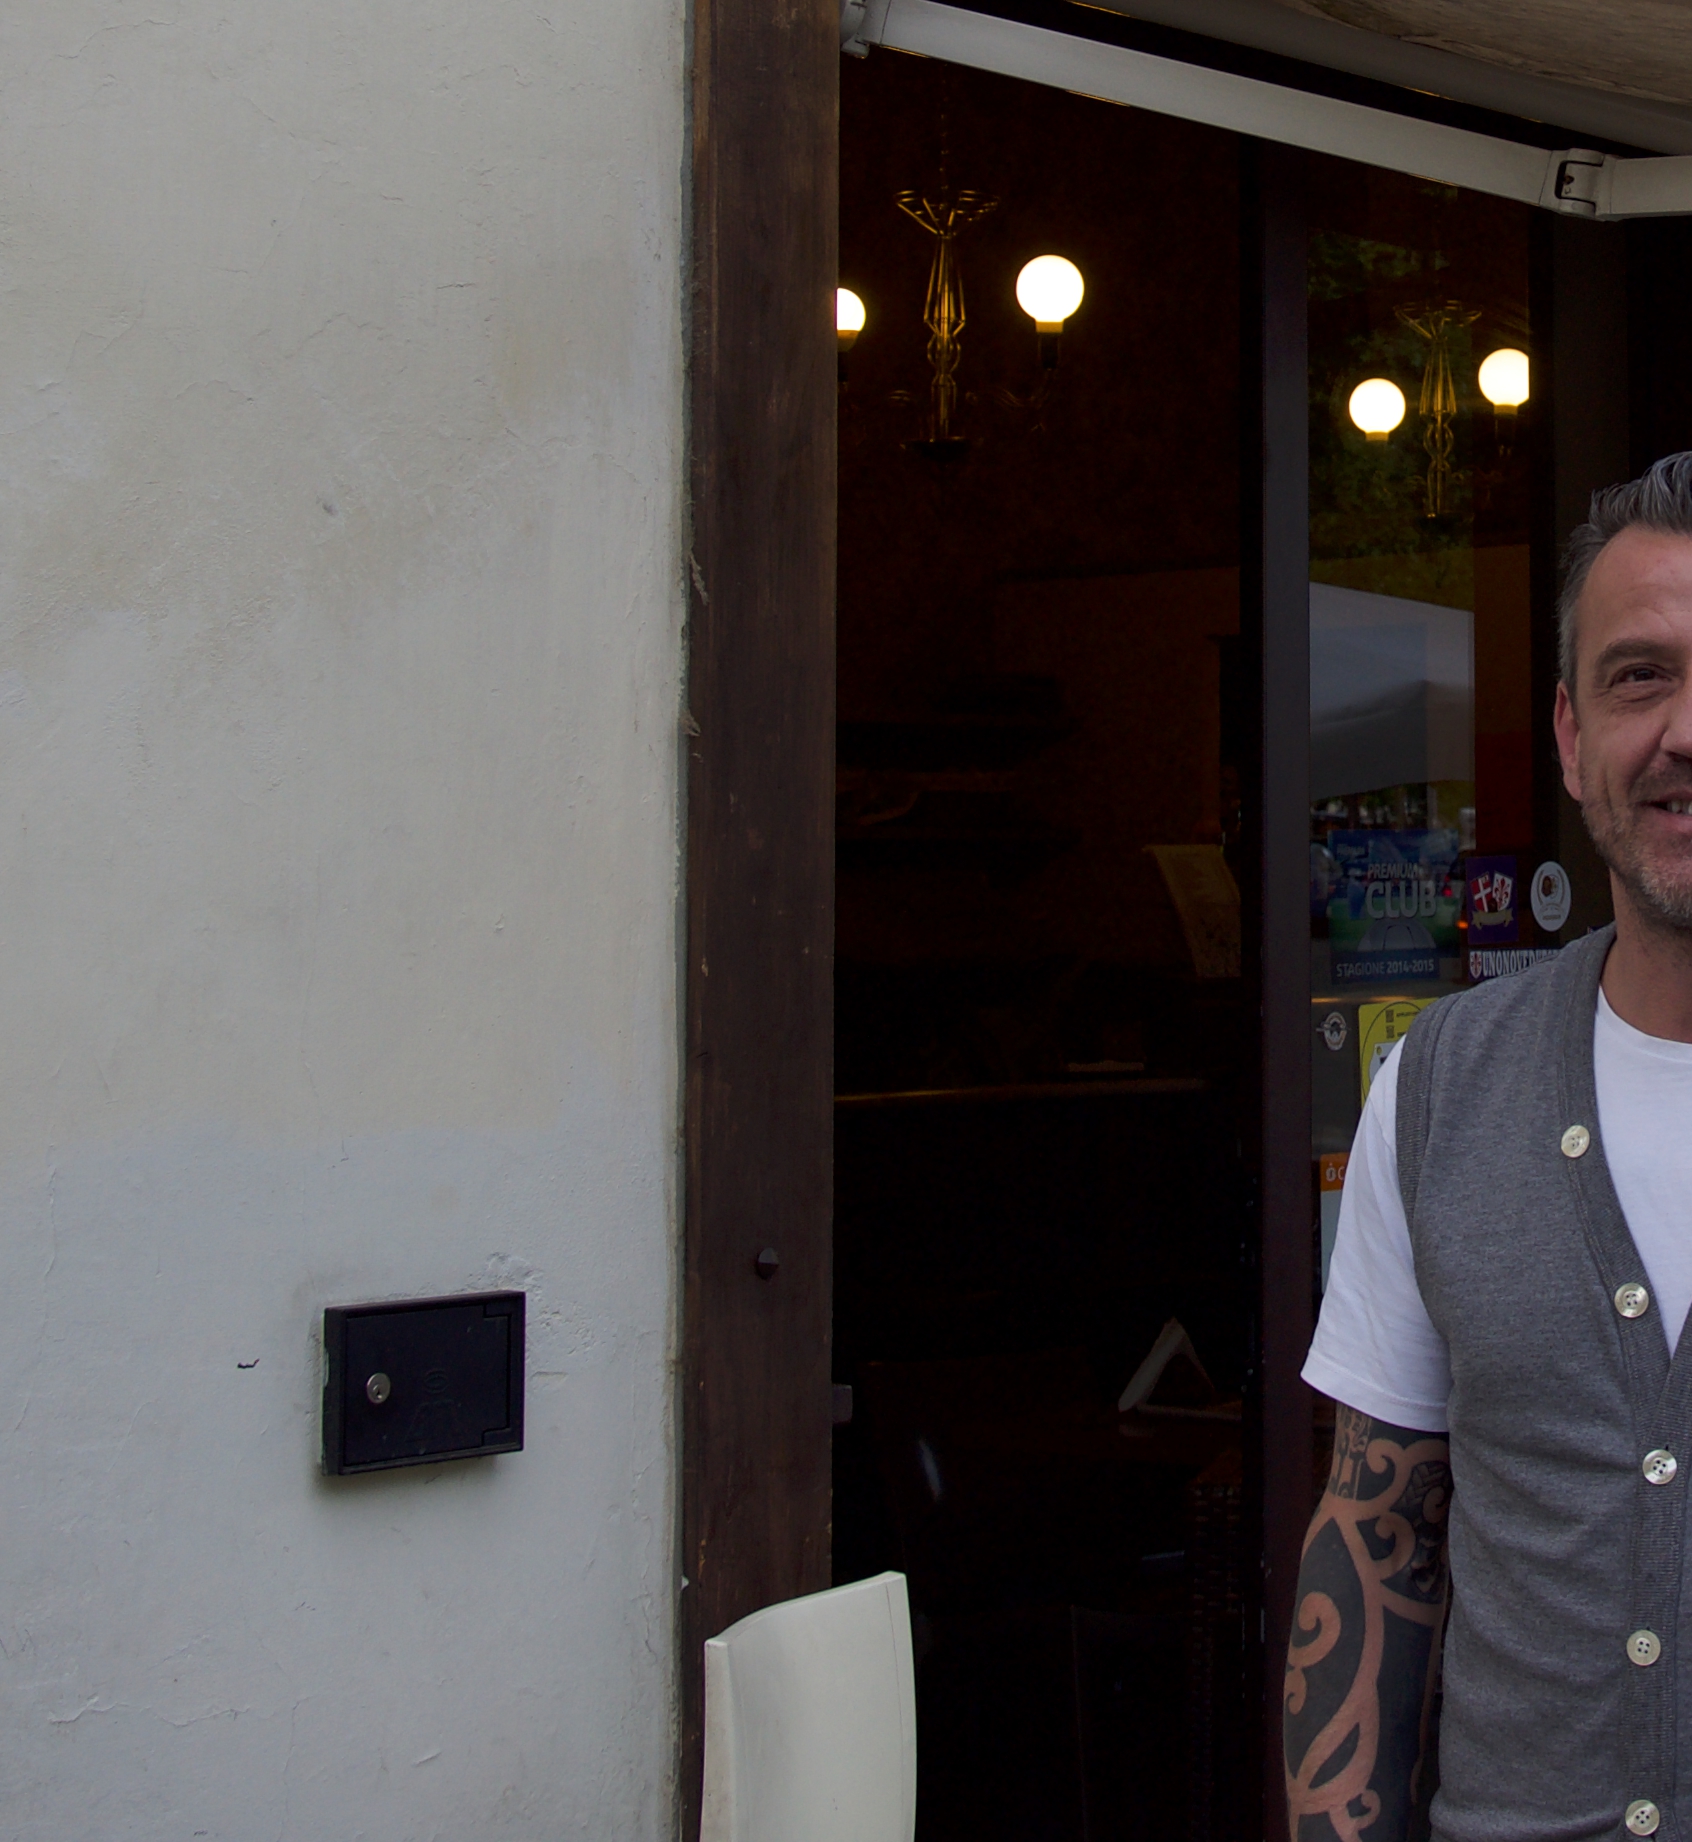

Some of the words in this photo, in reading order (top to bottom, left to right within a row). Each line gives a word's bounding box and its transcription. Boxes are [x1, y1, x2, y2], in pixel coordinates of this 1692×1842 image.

[1367, 863, 1420, 880] PREMIUM
[1365, 880, 1437, 920] CLUB
[1335, 961, 1385, 979] STAGIONE
[1386, 958, 1435, 975] 2014-2015
